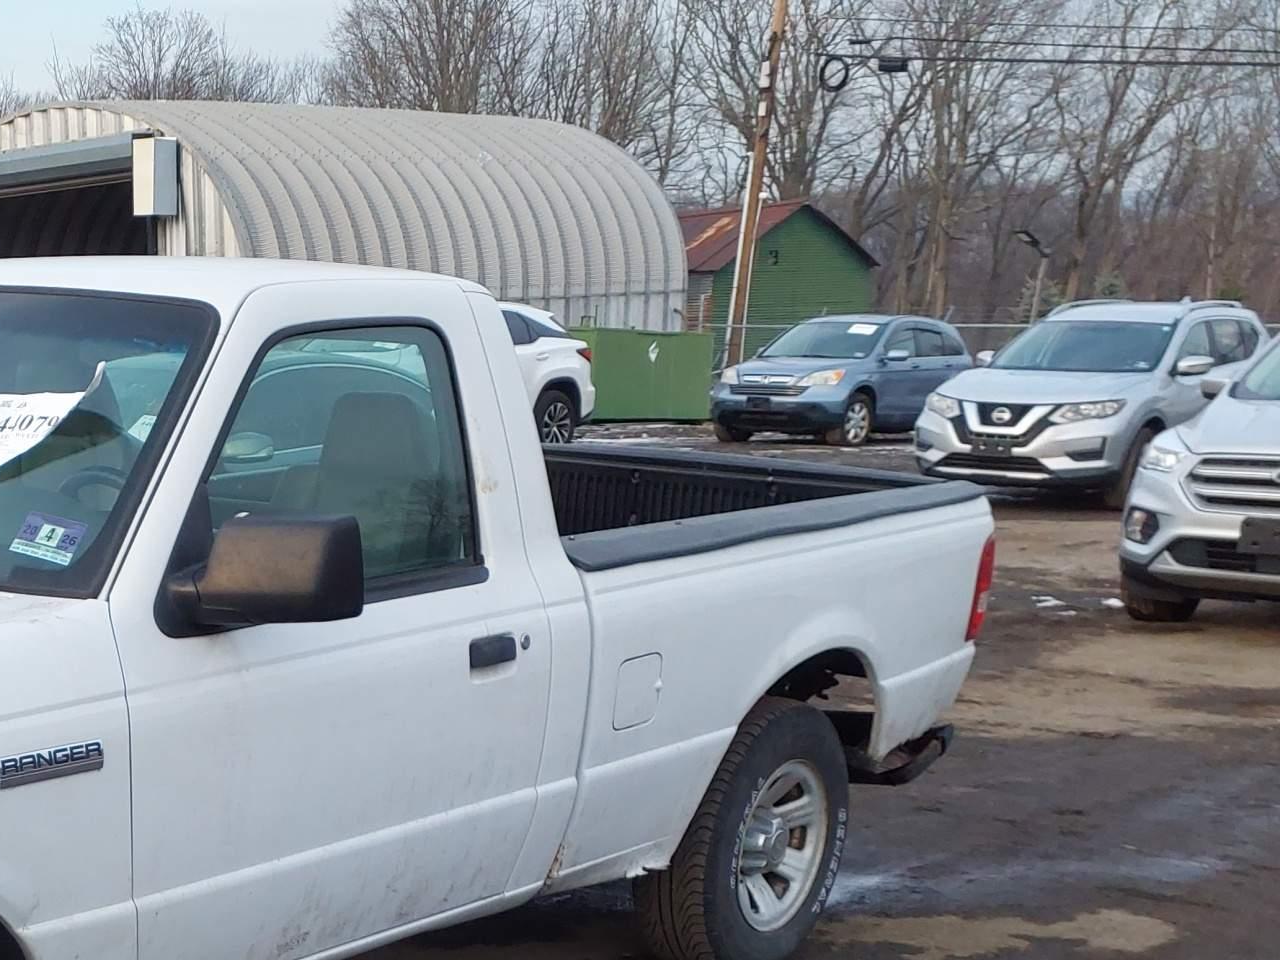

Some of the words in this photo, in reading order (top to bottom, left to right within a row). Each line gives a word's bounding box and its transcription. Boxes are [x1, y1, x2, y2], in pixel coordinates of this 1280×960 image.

[45, 527, 56, 542] 4
[61, 534, 79, 546] 26
[1, 742, 103, 776] RANGER
